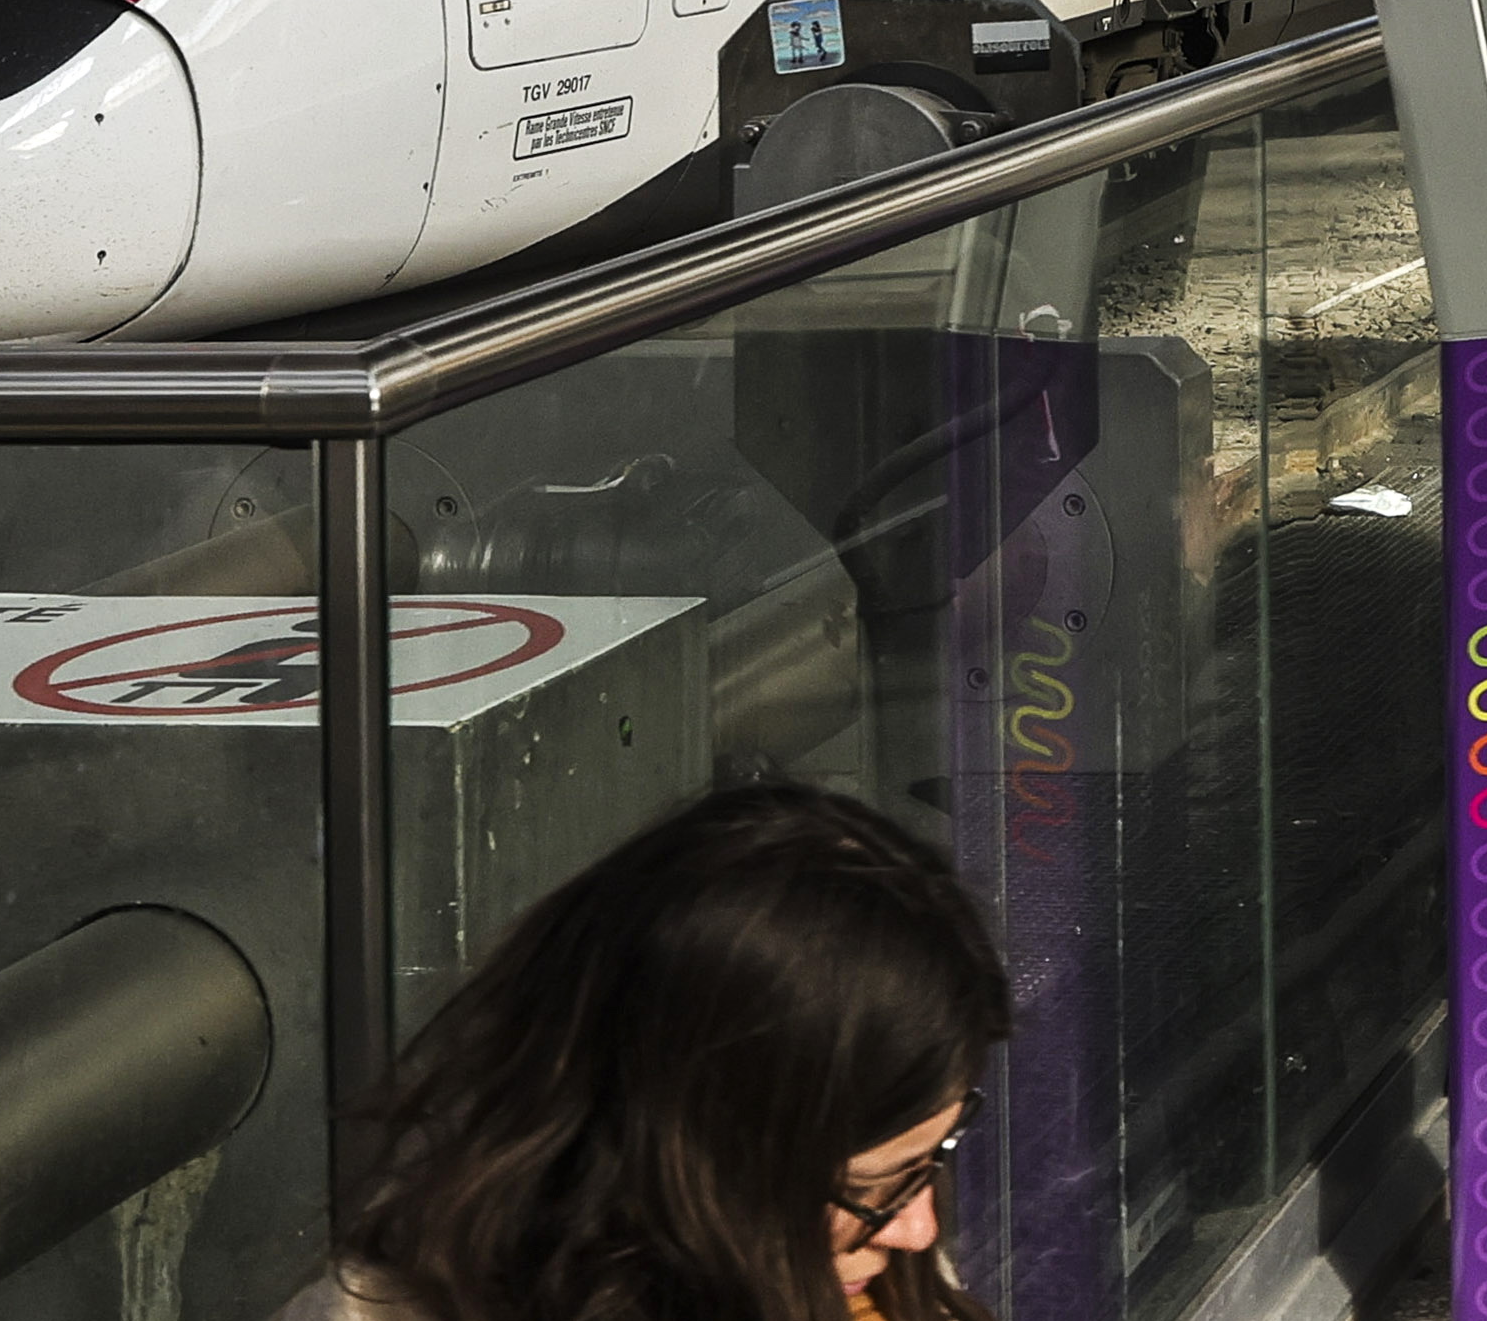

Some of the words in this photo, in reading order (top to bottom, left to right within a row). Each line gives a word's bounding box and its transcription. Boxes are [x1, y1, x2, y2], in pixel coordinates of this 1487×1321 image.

[523, 82, 551, 102] TGV
[557, 74, 592, 96] 29017
[525, 120, 544, 134] Rame
[546, 114, 568, 131] Grande
[569, 110, 592, 126] Vitesse
[530, 135, 542, 153] par
[543, 132, 554, 146] les
[599, 118, 616, 136] SNCF
